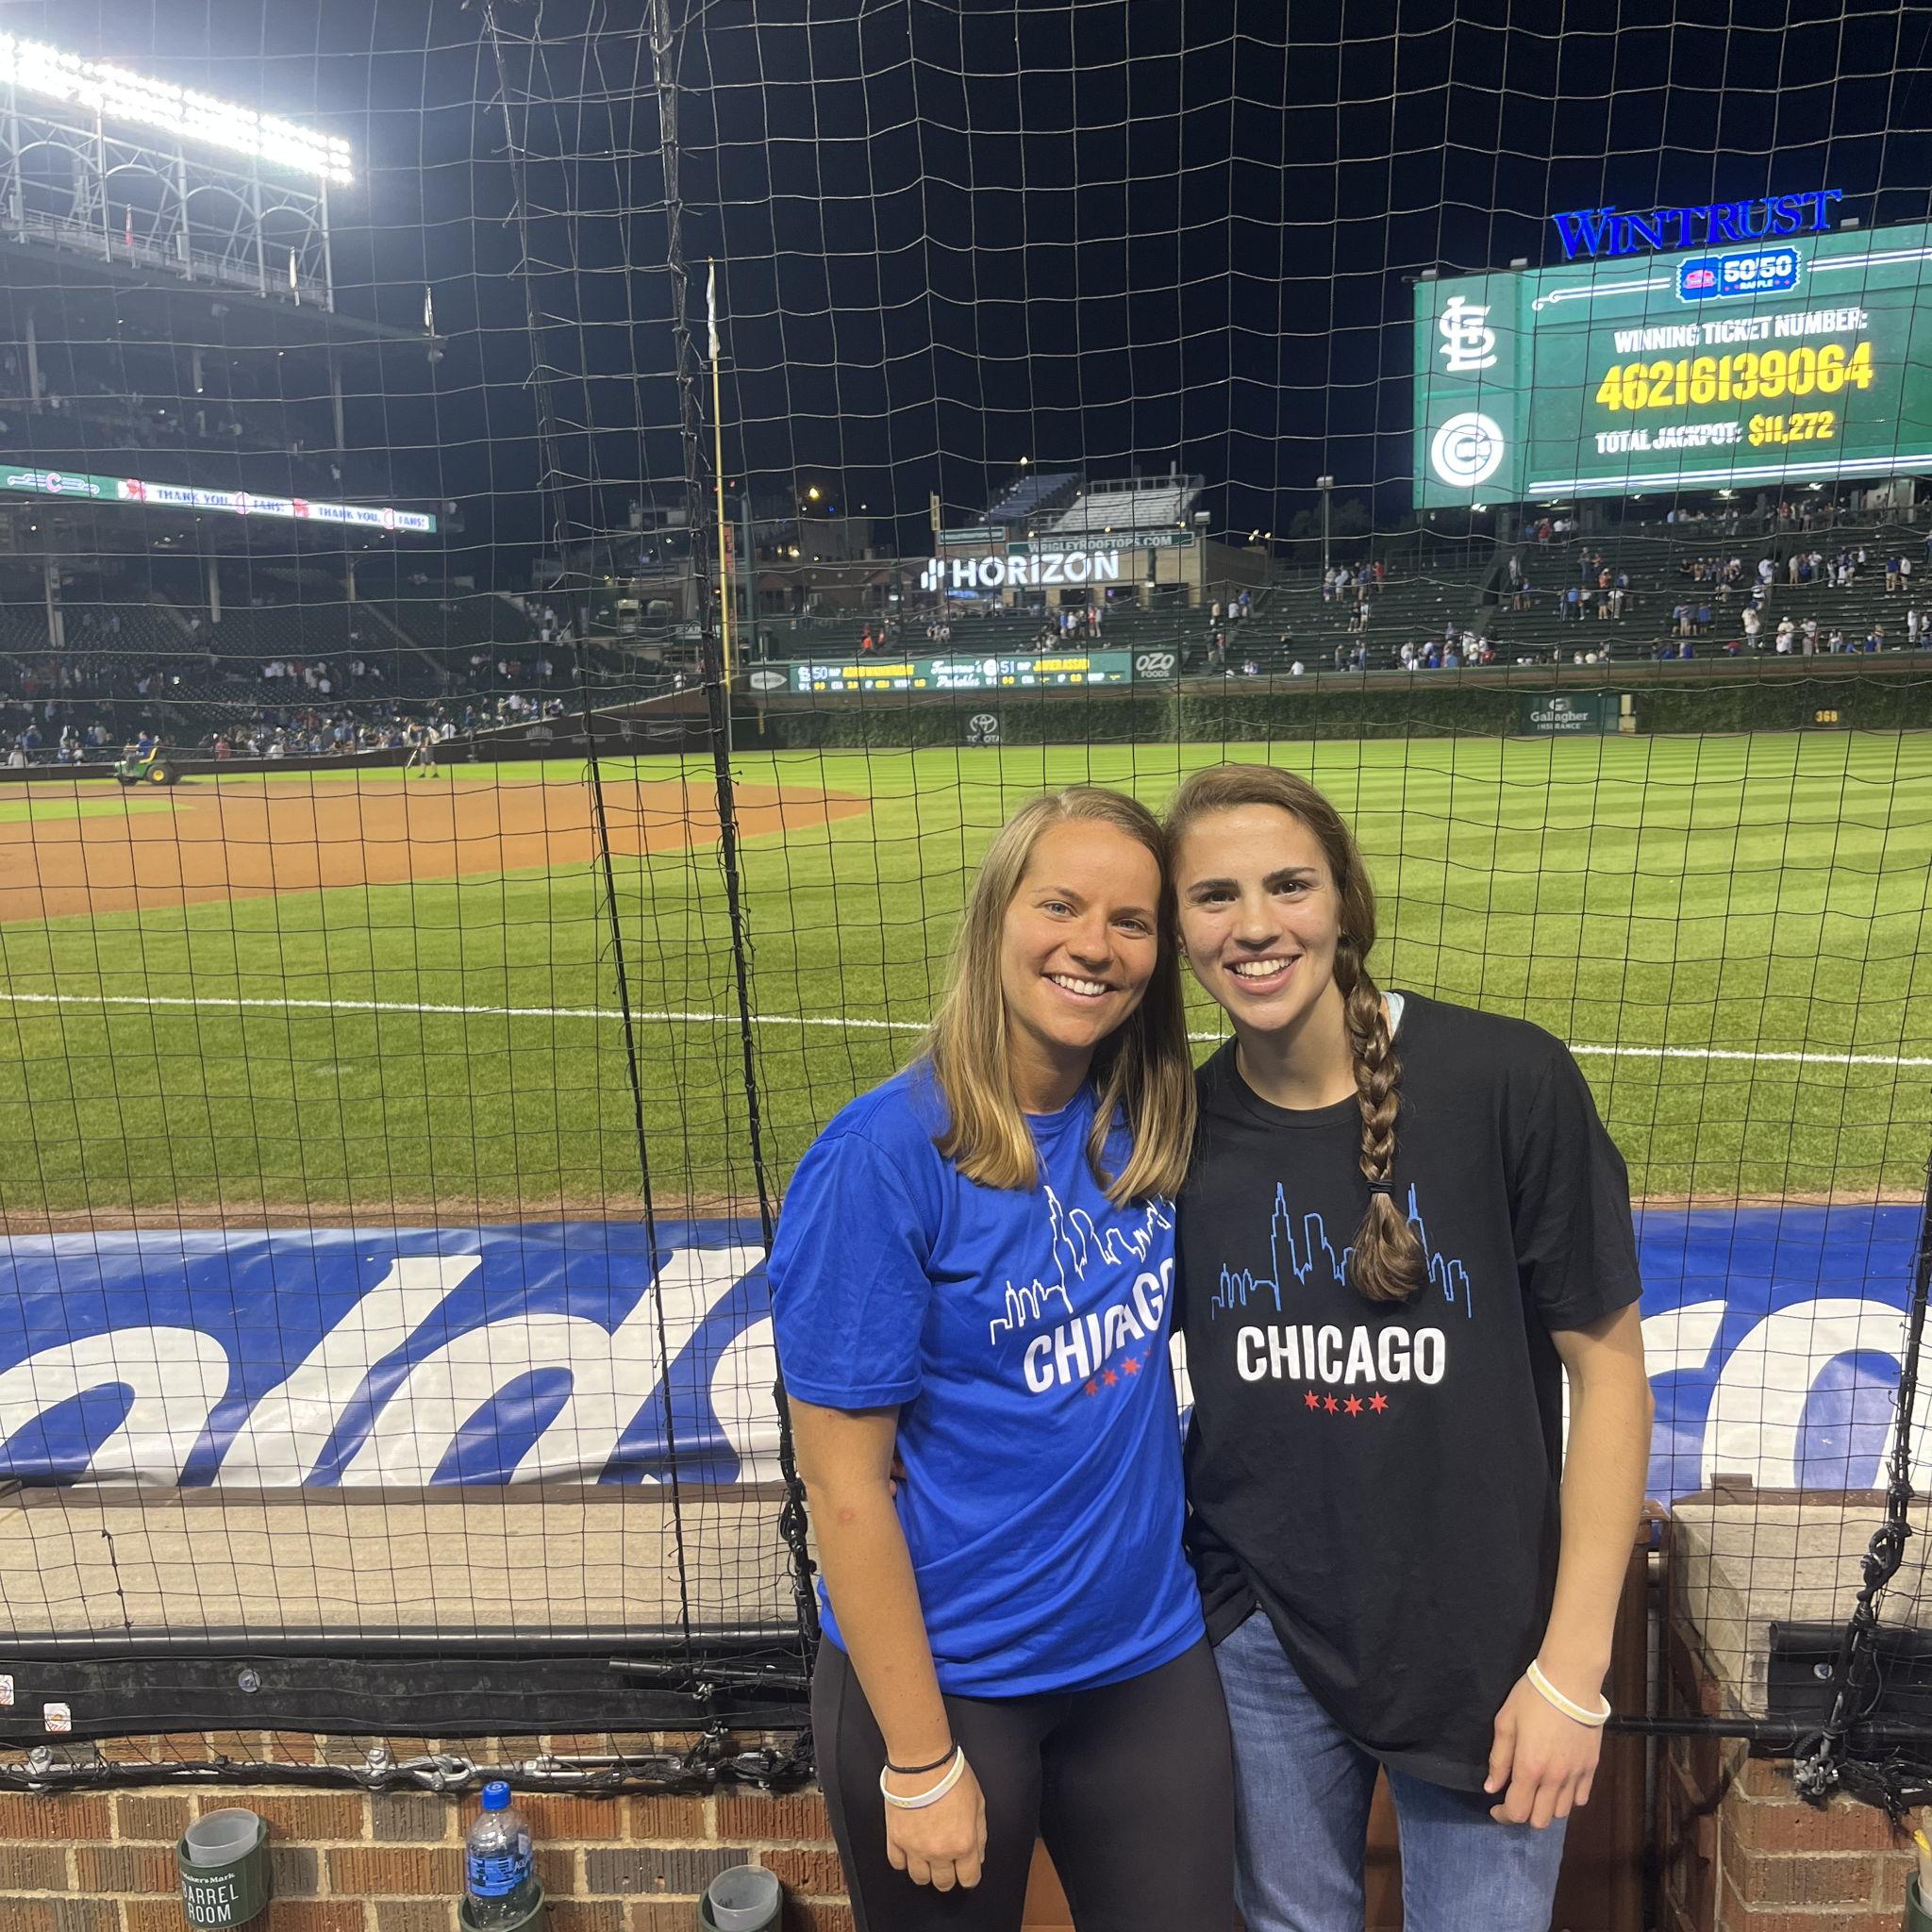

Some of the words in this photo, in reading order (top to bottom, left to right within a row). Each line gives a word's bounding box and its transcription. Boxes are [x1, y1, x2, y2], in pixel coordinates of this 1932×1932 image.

[1553, 189, 1842, 259] WINTRUST
[1724, 255, 1792, 282] 50/50
[1614, 324, 1701, 354] WINNING
[1702, 316, 1772, 344] TICKET
[1774, 307, 1868, 338] NUMBER:
[1595, 341, 1874, 411] 46216139064
[1595, 428, 1652, 454] TOTAL
[1653, 422, 1743, 451] JACKPOT:
[1748, 410, 1835, 447] $11,272
[158, 489, 197, 504] THANK
[318, 507, 354, 520] THANK
[952, 550, 1120, 587] HORIZON
[1000, 660, 1015, 674] 51
[1136, 653, 1175, 671] OZO
[1141, 670, 1170, 678] FOODS
[1530, 710, 1589, 723] Gallagher
[1237, 1324, 1446, 1386] CHICAGO
[210, 1873, 236, 1884] Mark
[181, 1880, 240, 1906] BARREL
[188, 1902, 232, 1924] ROOM
